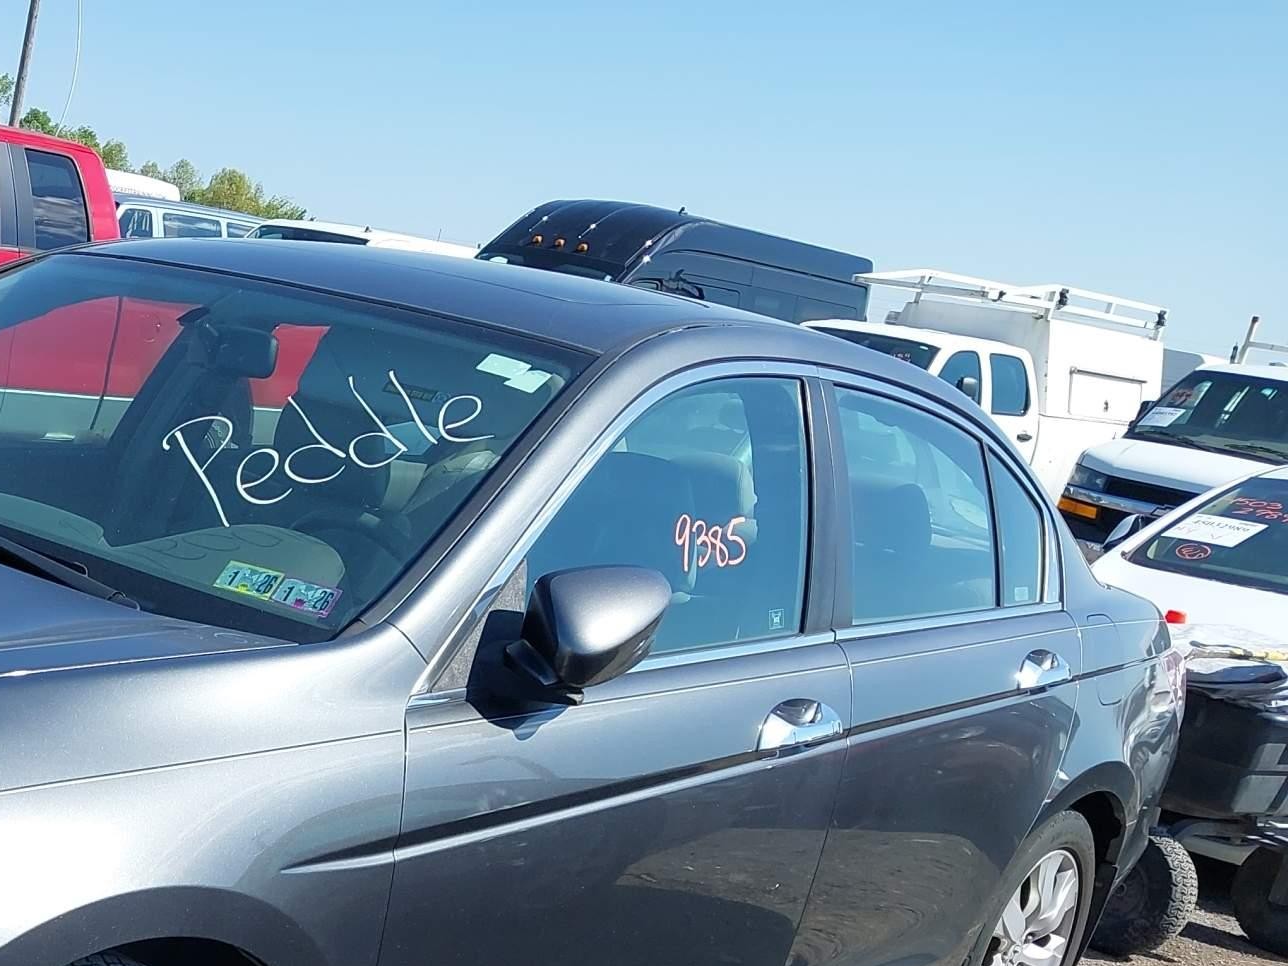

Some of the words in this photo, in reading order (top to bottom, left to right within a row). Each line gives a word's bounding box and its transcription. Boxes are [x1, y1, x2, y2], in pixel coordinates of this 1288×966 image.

[162, 370, 495, 528] Peddle
[675, 513, 746, 573] 9385
[256, 574, 278, 595] 26
[312, 590, 334, 611] 26
